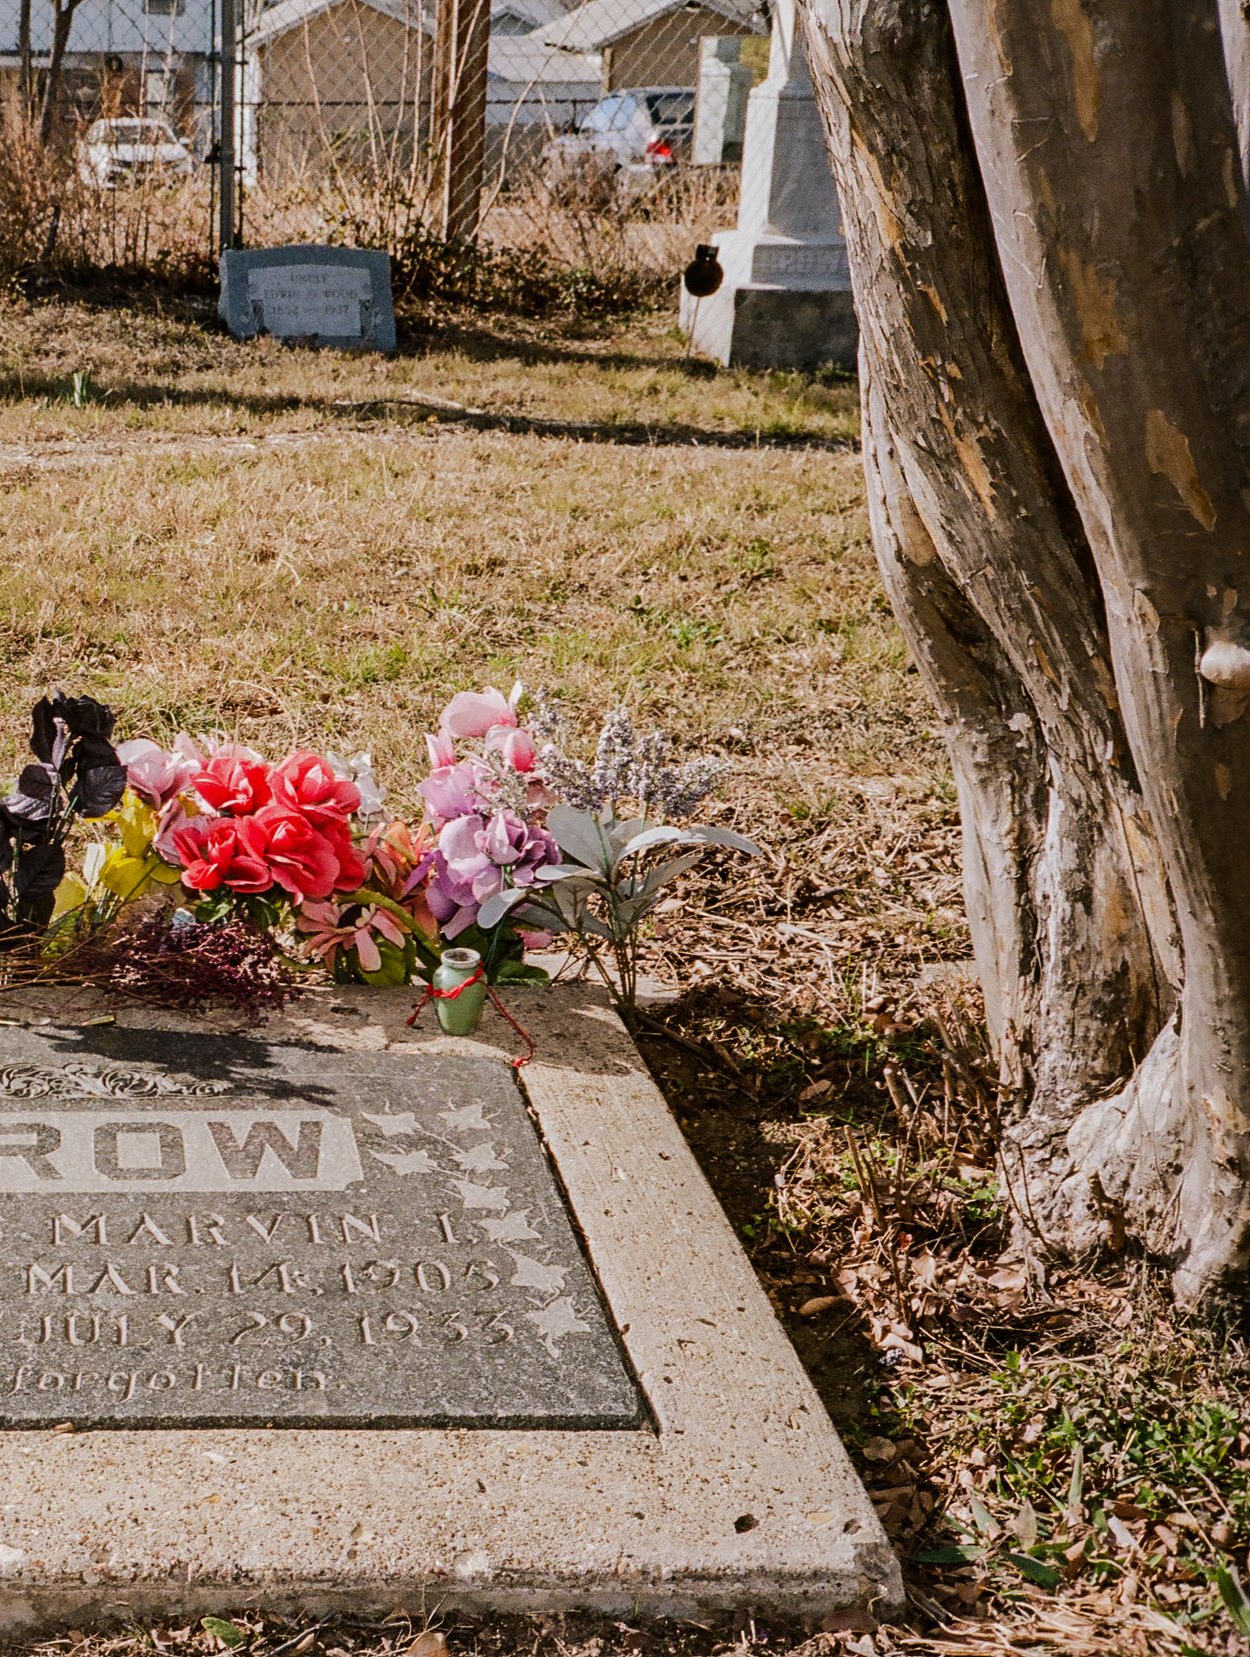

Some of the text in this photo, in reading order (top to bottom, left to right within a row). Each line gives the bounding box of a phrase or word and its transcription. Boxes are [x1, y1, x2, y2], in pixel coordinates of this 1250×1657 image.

[49, 1211, 382, 1248] MARVIN
[24, 1259, 501, 1297] MAR. 14, 1905
[13, 1308, 202, 1347] JULY
[359, 1309, 515, 1347] 1933
[0, 1362, 328, 1403] forgotten
